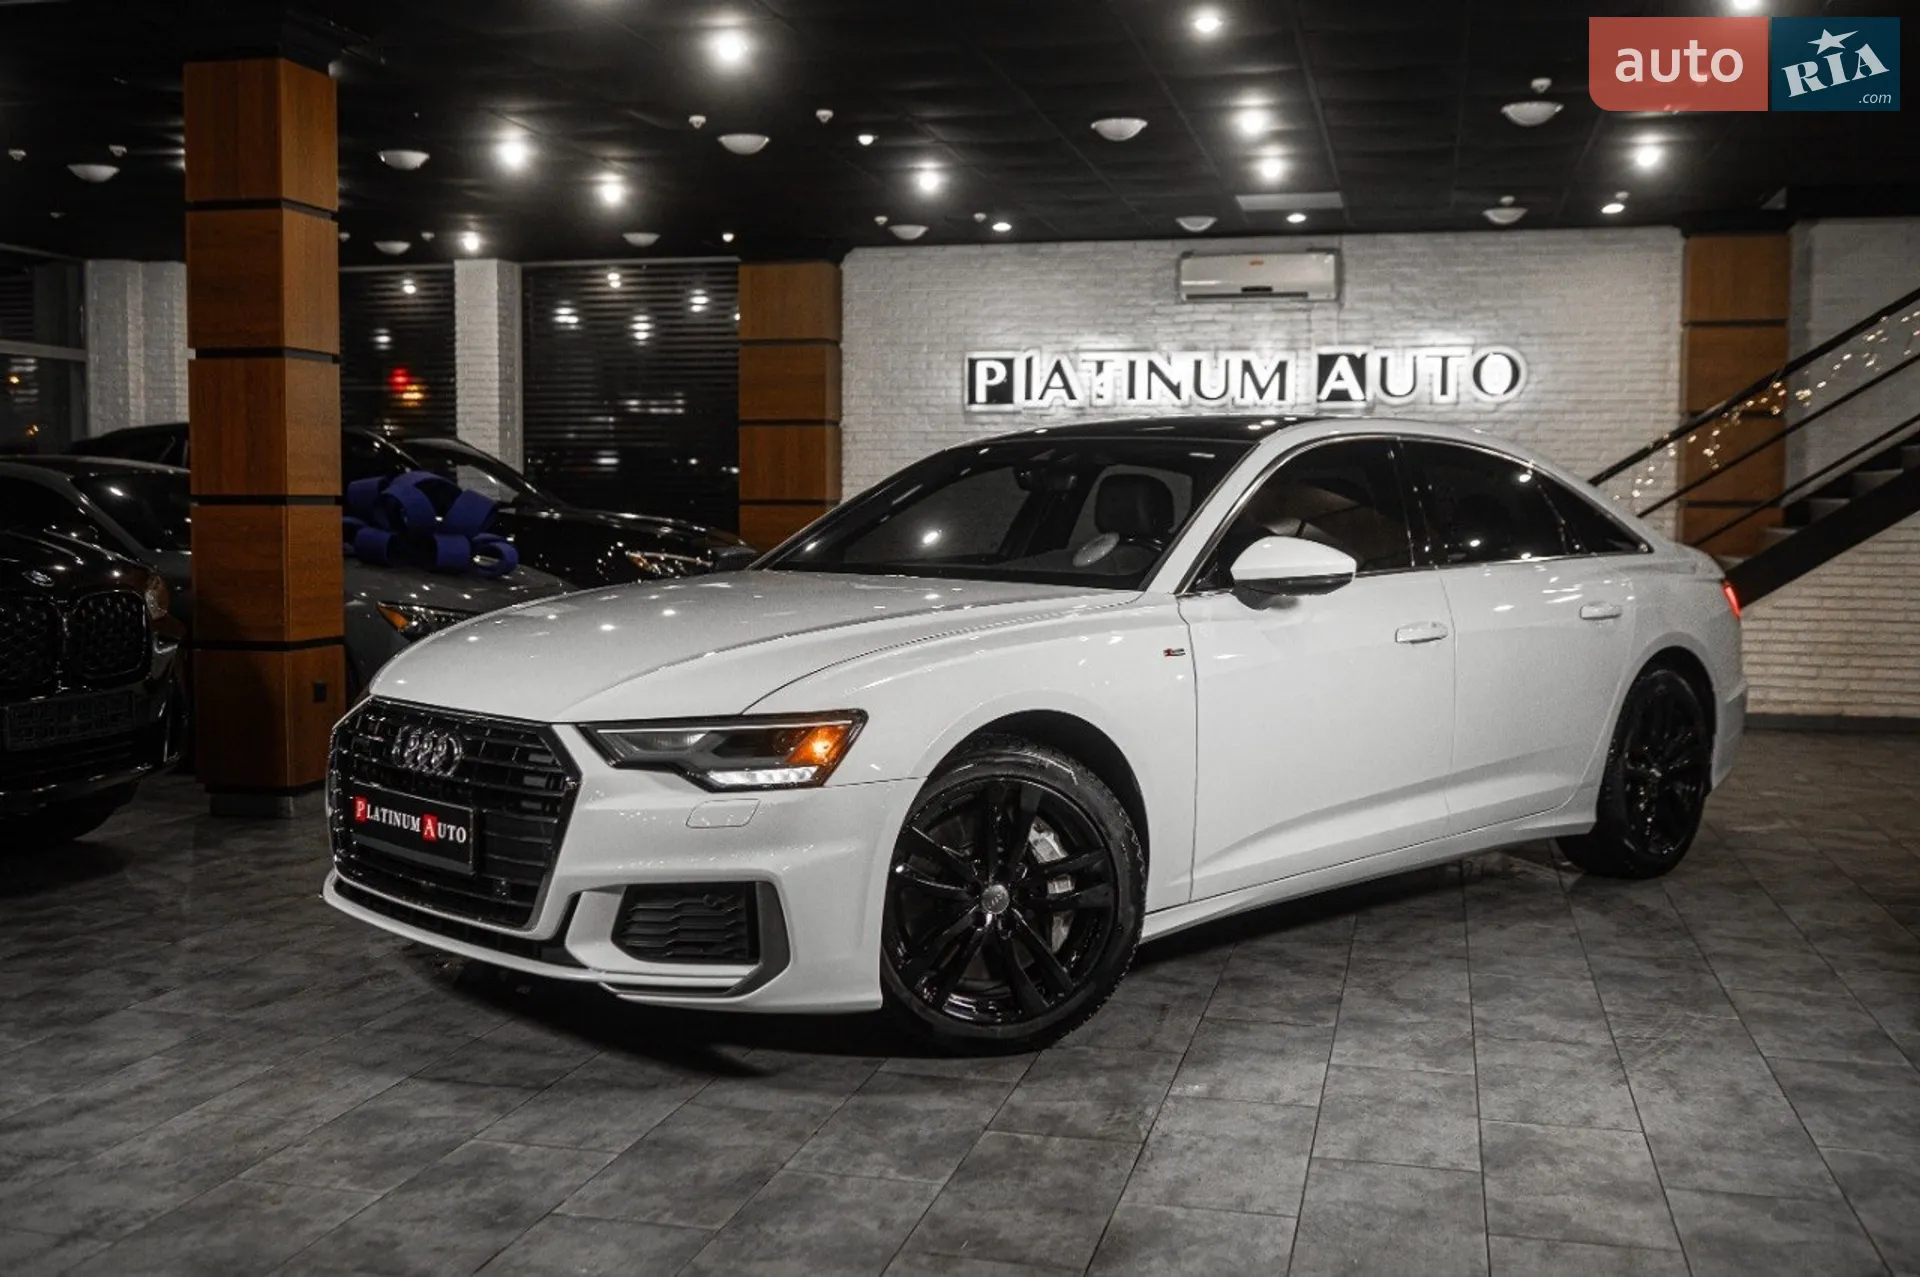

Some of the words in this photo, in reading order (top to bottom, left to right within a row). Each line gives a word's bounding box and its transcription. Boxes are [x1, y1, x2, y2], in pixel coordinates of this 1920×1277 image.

[968, 356, 1288, 404] PLATINUM
[1317, 353, 1522, 402] AUTO
[355, 798, 421, 833] PLATINUM
[423, 816, 467, 843] AUTO
